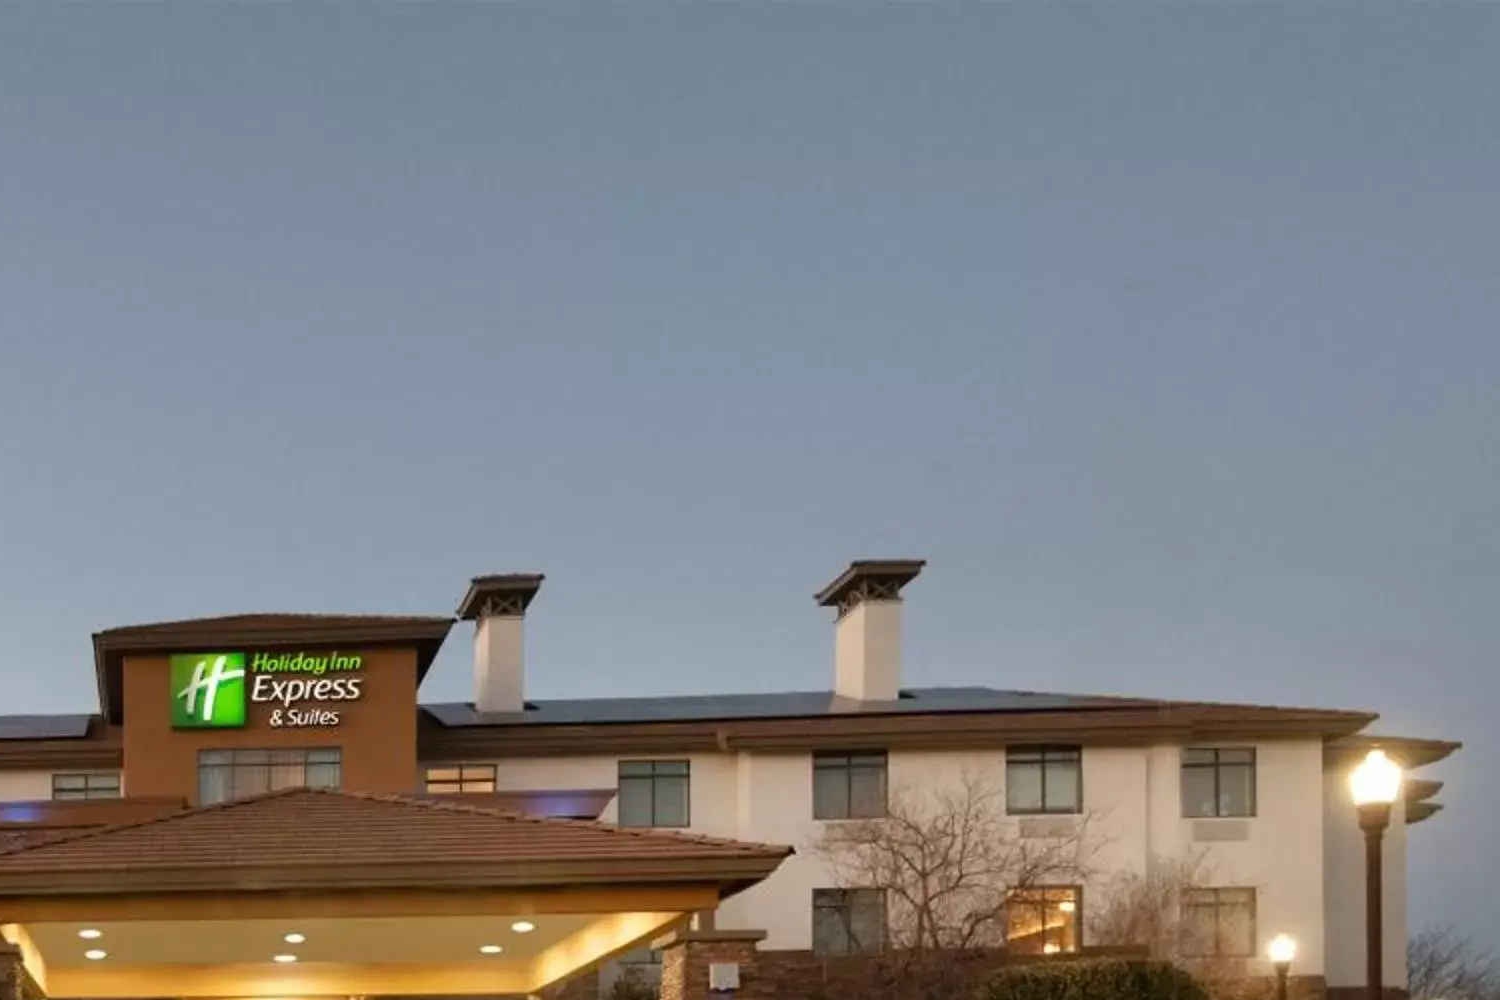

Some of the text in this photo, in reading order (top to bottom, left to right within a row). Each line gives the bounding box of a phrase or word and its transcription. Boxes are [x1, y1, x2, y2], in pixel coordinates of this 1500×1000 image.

[252, 652, 361, 675] Holiday Inn
[252, 675, 362, 707] Express
[269, 708, 339, 726] & Suites
